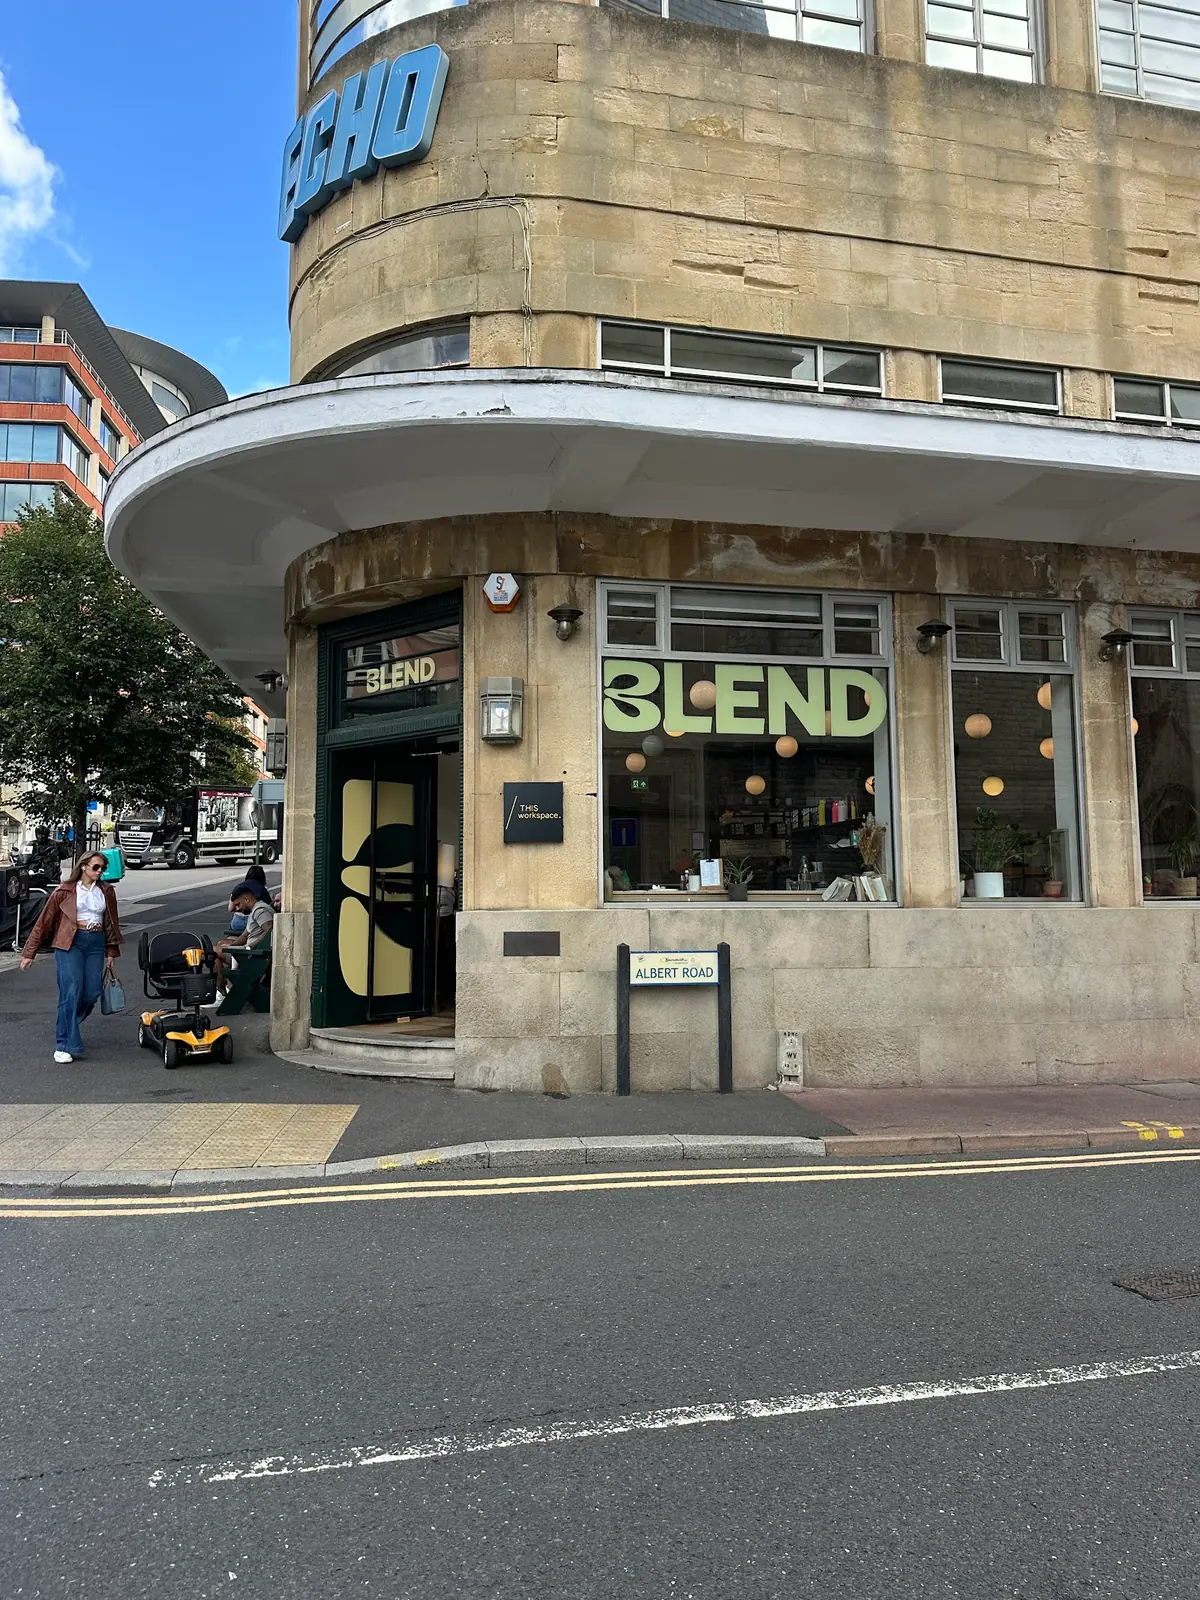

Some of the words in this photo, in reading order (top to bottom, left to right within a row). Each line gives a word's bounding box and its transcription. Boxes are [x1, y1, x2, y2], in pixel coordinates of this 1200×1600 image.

[366, 657, 436, 693] BLEND
[603, 659, 888, 737] BLEND
[520, 804, 539, 812] THIS
[517, 812, 562, 820] workspace.
[636, 967, 678, 978] ALBERT
[683, 967, 713, 977] ROAD
